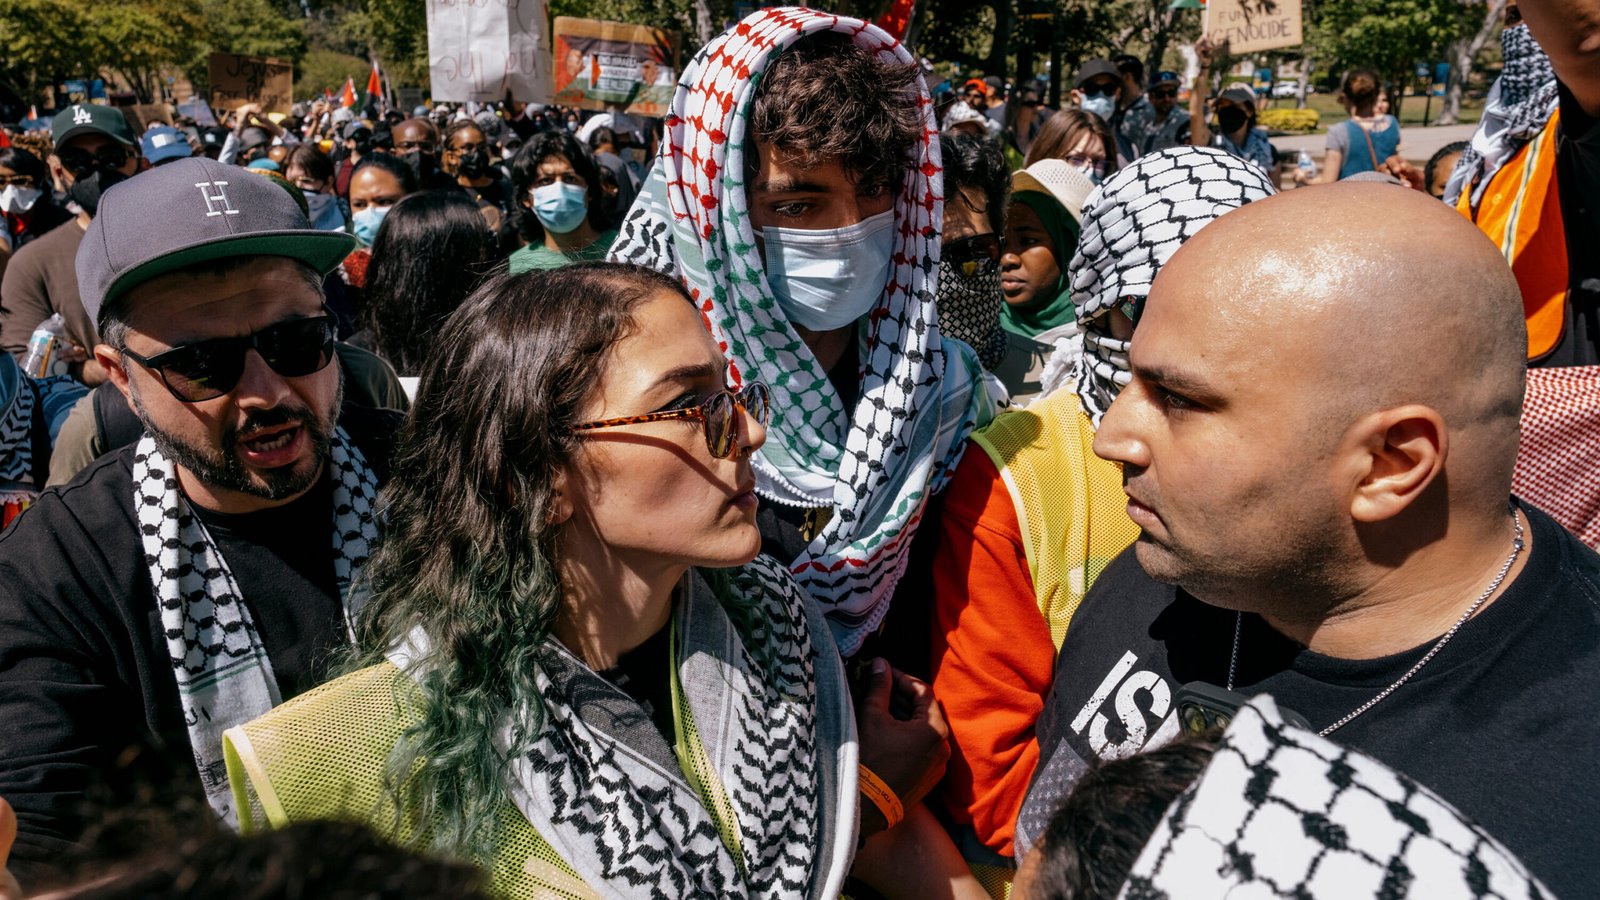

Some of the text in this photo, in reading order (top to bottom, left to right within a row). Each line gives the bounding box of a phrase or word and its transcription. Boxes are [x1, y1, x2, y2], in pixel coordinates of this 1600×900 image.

[1212, 17, 1291, 46] GENOCIDE
[72, 105, 92, 124] LA
[195, 181, 239, 217] H
